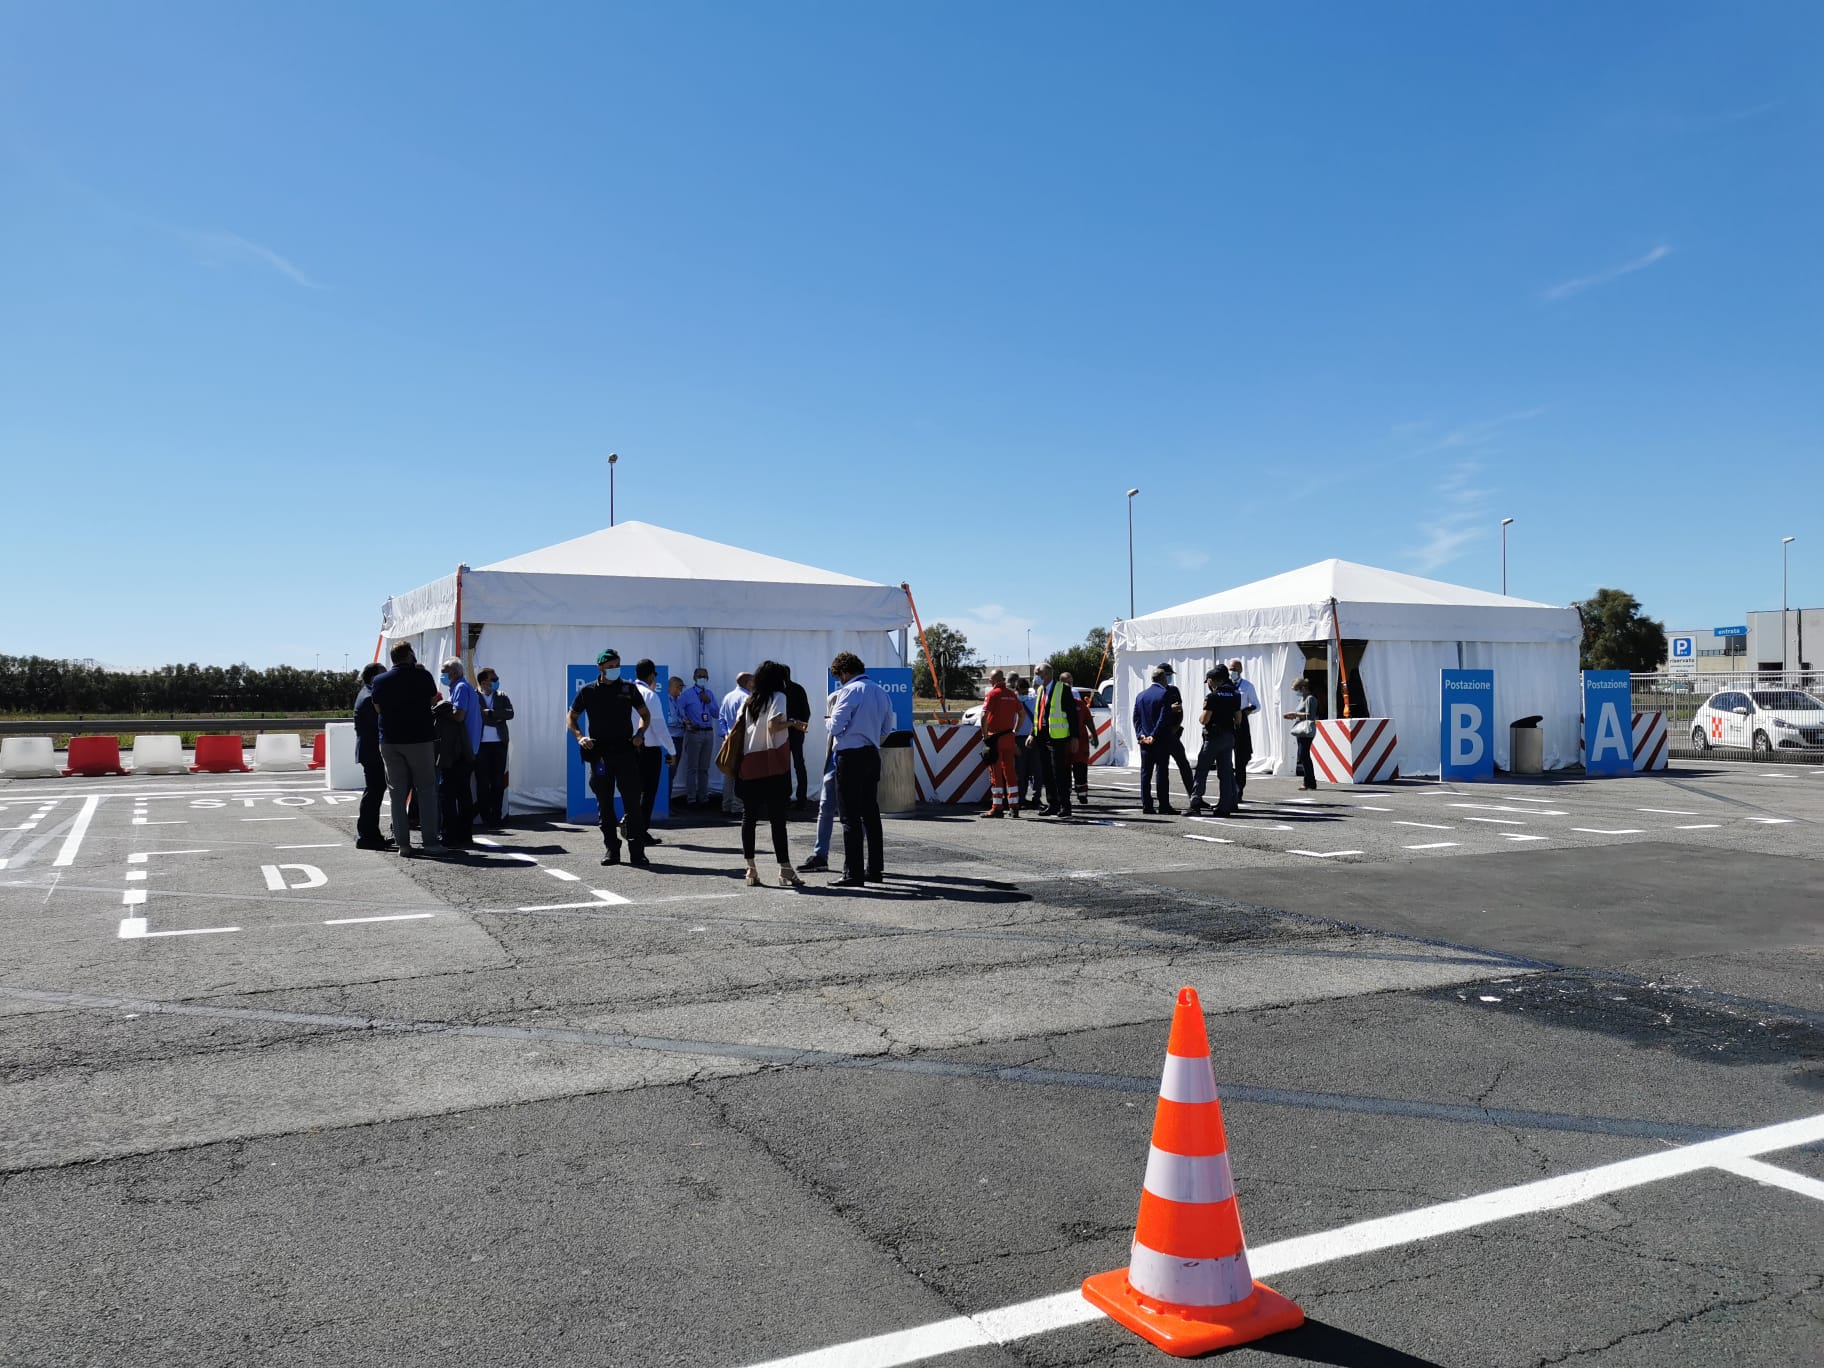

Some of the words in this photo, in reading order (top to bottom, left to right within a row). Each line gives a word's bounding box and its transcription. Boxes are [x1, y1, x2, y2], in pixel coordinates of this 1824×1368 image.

[1676, 640, 1688, 656] P
[1445, 679, 1491, 690] Postazione
[1586, 679, 1628, 689] Postazione
[1450, 703, 1484, 766] B
[1591, 702, 1629, 762] A
[188, 795, 358, 809] STOP
[260, 863, 329, 891] D
